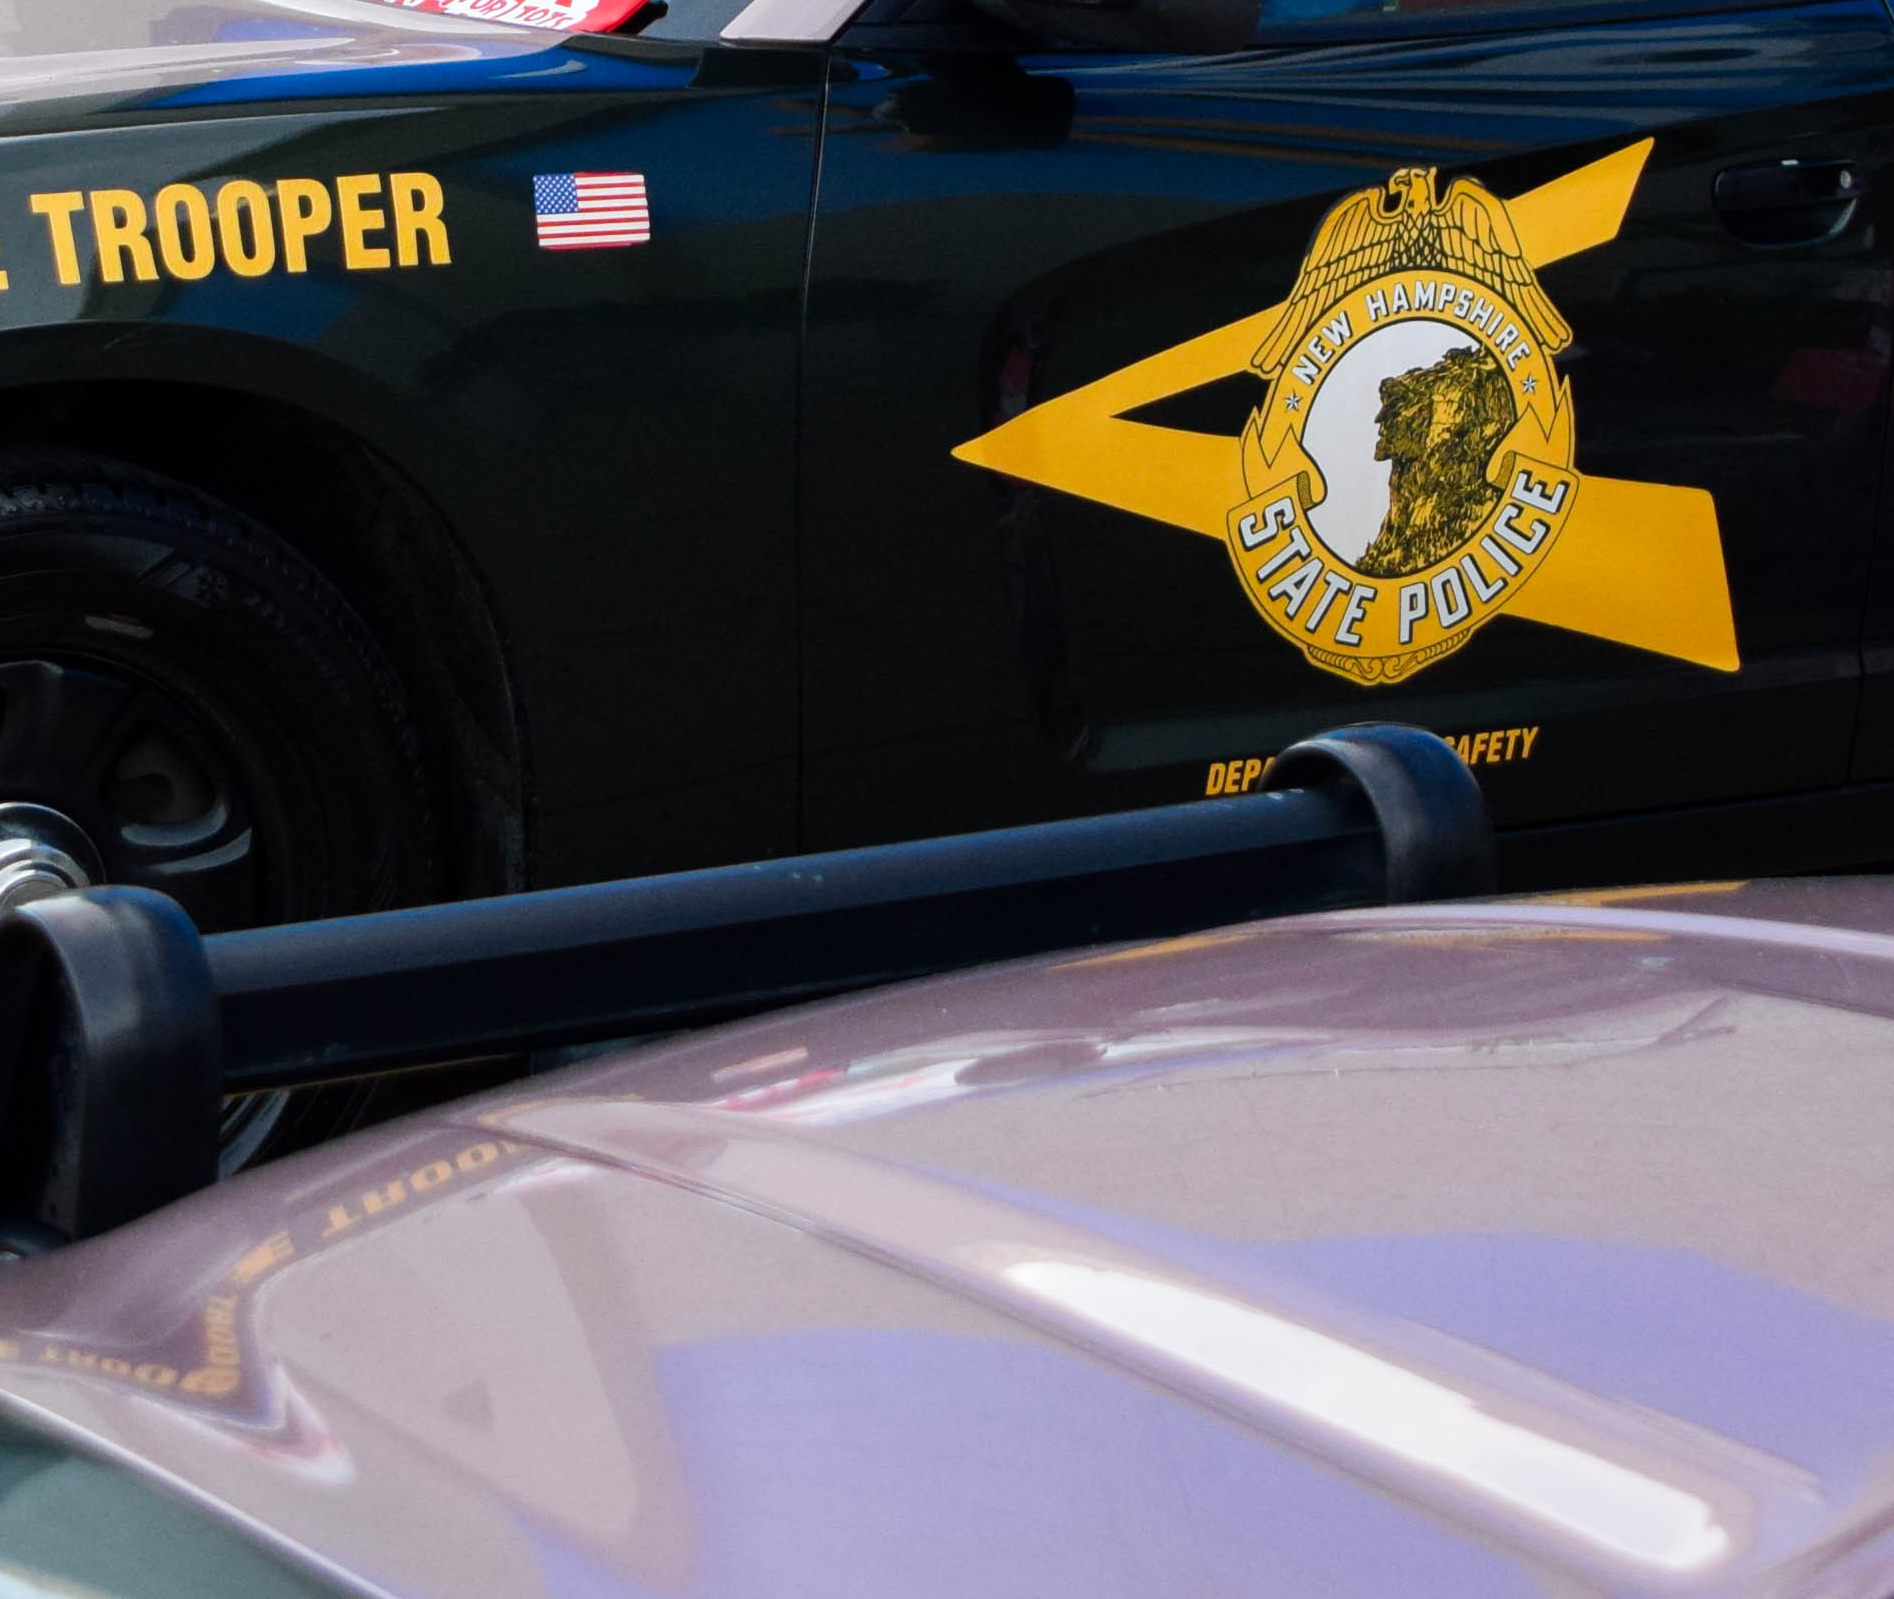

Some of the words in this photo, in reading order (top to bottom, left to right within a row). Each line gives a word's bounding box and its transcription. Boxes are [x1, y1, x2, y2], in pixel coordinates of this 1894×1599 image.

[28, 171, 451, 286] TROOPER
[1292, 312, 1352, 386] NEW
[1365, 280, 1531, 369] HAMPSHIRE
[1237, 493, 1378, 647] STATE
[1395, 468, 1571, 645] POLICE
